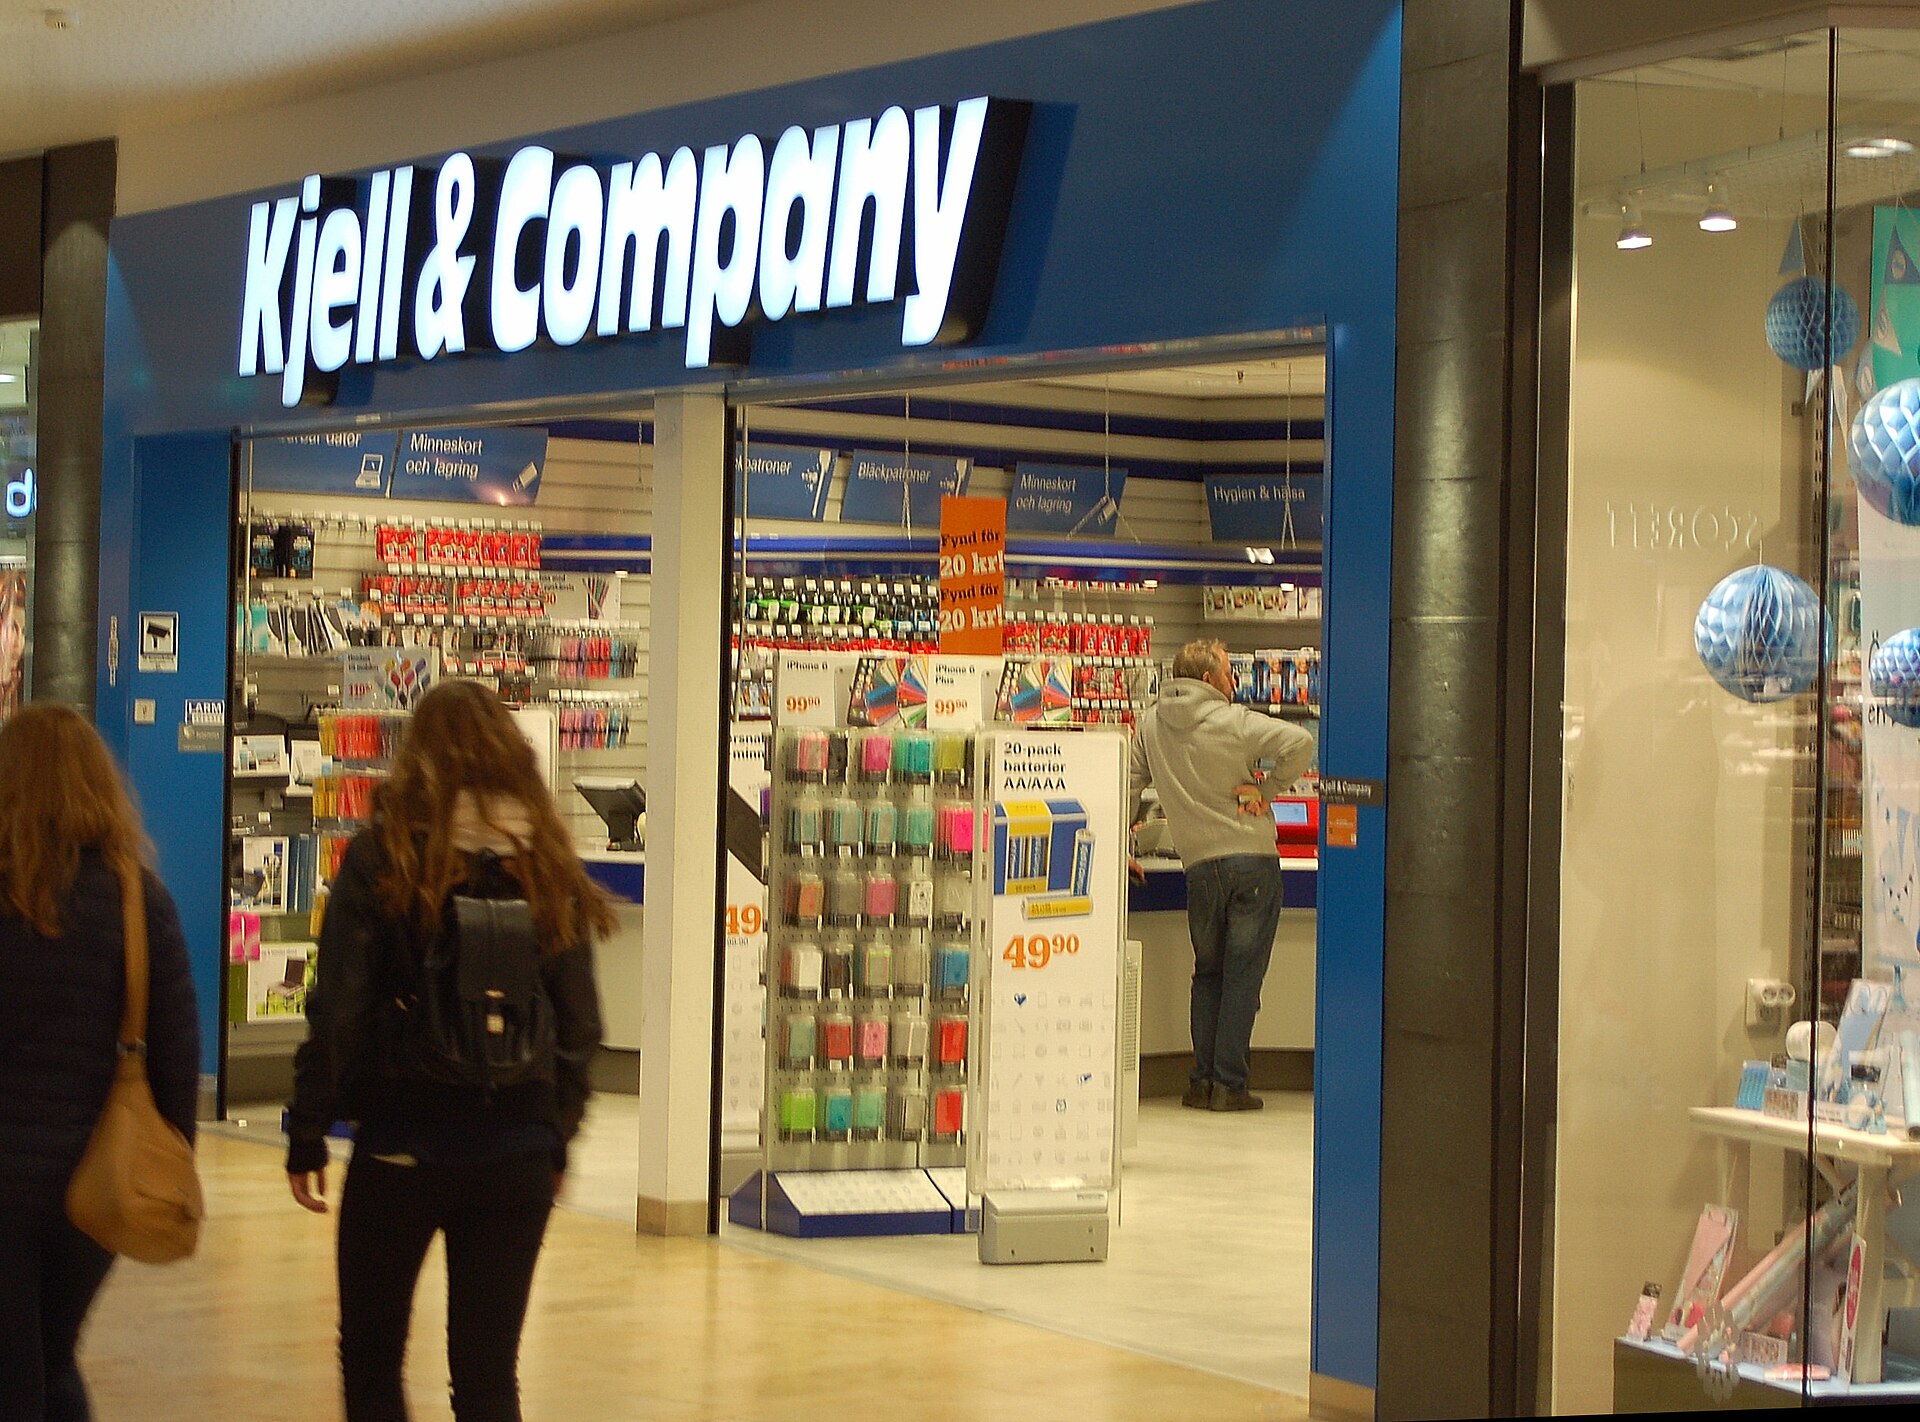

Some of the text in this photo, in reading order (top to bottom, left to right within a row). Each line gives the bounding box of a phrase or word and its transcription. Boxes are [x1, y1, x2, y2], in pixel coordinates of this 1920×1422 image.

[238, 96, 989, 408] Kjell & Company
[411, 432, 483, 456] Minneskort
[405, 456, 479, 482] och lagring
[858, 461, 931, 483] Bläckpatroner
[1020, 473, 1076, 493] Minneskort
[1214, 485, 1256, 504] Hygien
[1260, 484, 1270, 500] &
[1016, 494, 1073, 515] och lagring
[941, 529, 1000, 549] Fynd för
[940, 550, 1005, 578] 20 kr!
[940, 583, 998, 603] Fynd för
[939, 603, 1003, 633] 20 kr!
[1004, 742, 1062, 758] 20-pack
[1004, 759, 1066, 773] batterier
[1004, 776, 1066, 790] AA/AAA
